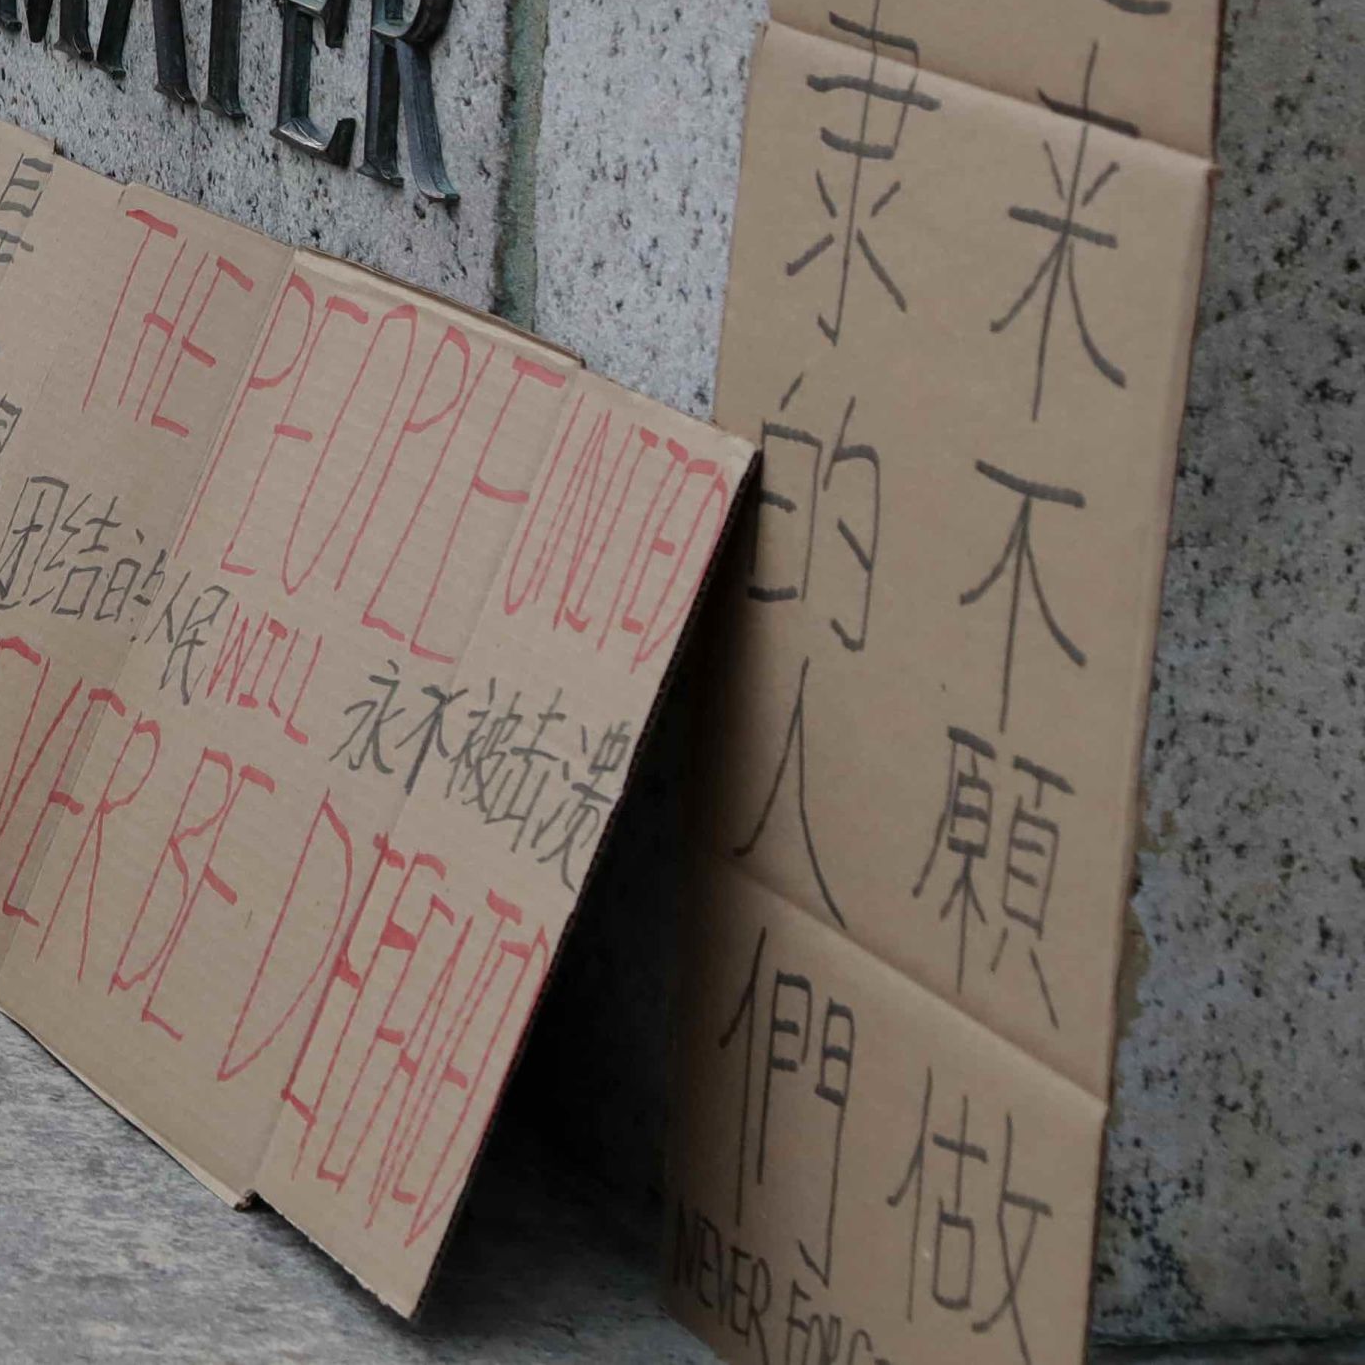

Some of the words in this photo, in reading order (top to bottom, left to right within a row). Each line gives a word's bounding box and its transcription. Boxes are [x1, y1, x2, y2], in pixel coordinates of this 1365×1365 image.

[81, 208, 254, 438] THE
[174, 269, 566, 664] PEOPLE
[504, 393, 731, 673] UNITED
[205, 602, 325, 745] WILL
[107, 746, 276, 1041] BE
[671, 1199, 771, 1365] NEVER
